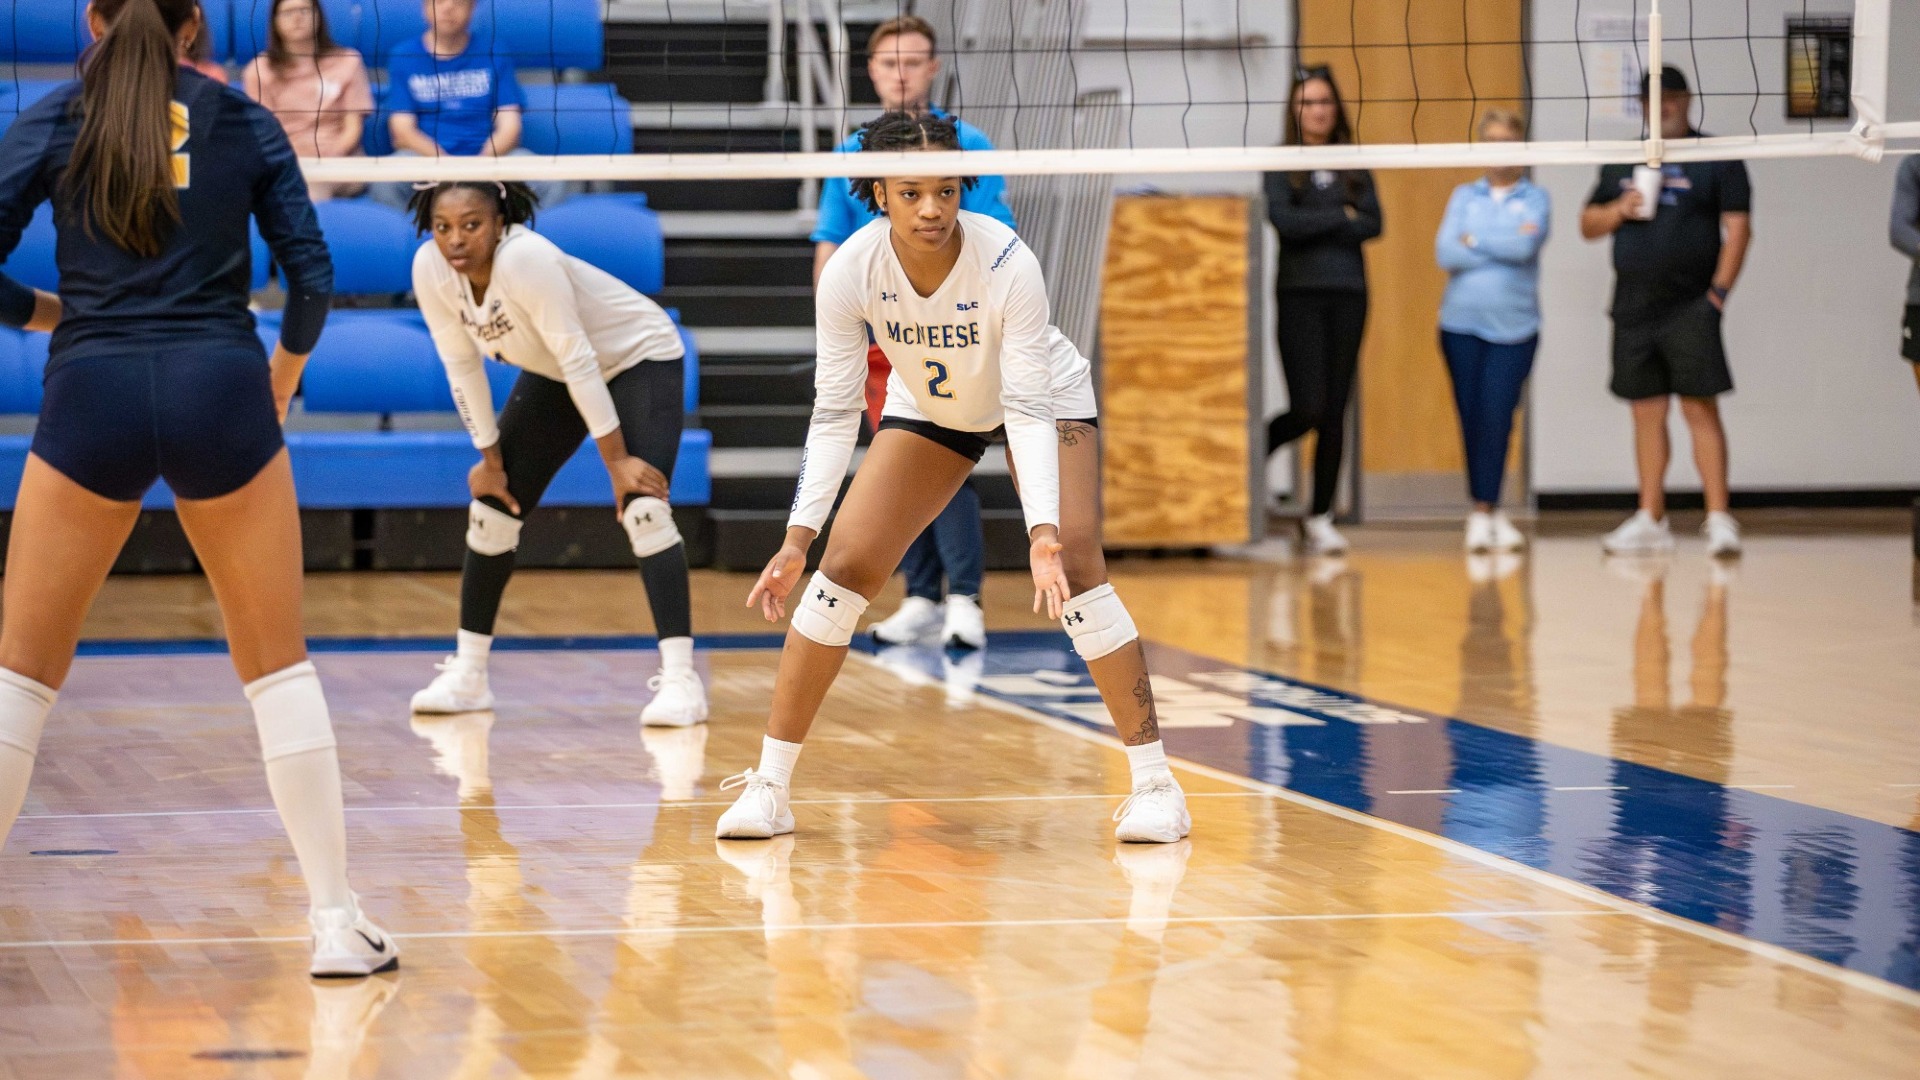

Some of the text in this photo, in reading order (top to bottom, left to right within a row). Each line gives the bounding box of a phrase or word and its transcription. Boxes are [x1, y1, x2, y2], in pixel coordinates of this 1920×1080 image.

[956, 301, 979, 311] SLC
[886, 320, 980, 348] McNEESE
[922, 357, 957, 400] 2
